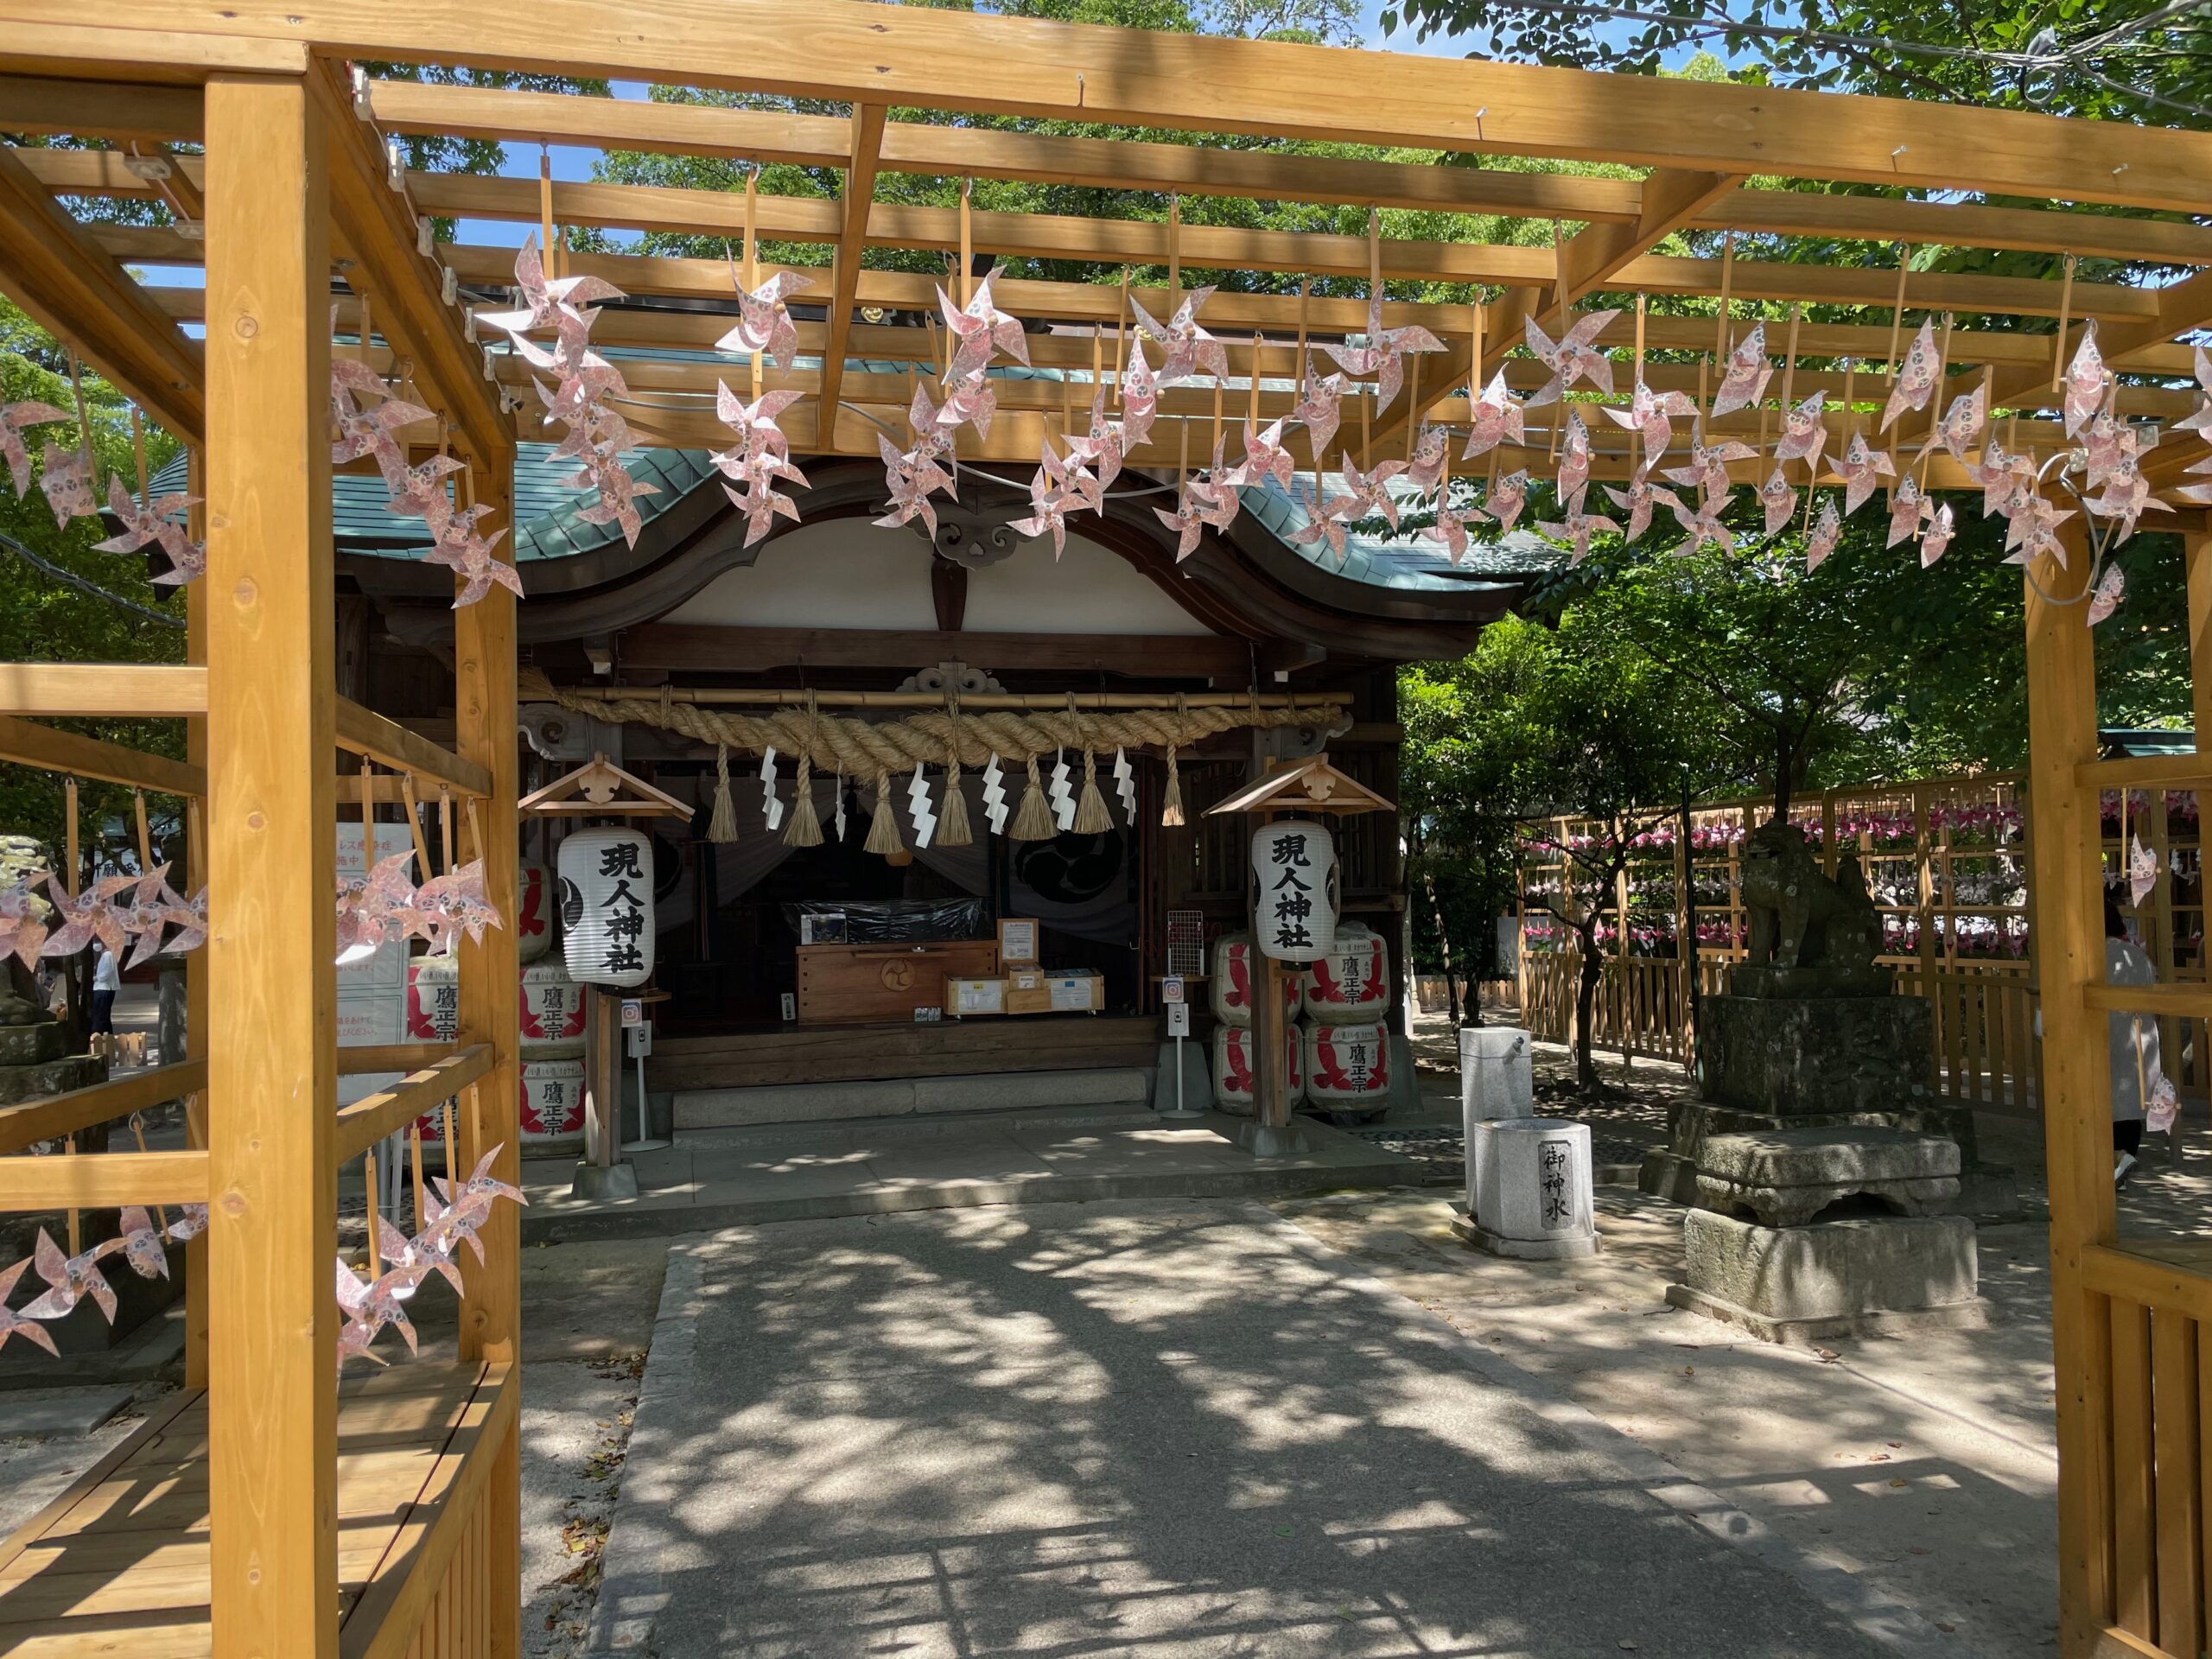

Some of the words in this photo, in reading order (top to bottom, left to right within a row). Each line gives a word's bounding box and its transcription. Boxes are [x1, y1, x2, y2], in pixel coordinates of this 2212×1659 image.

[599, 842, 645, 974] 現人神社
[1271, 834, 1313, 949] 現人神社
[1342, 956, 1361, 1005] 鷹正宗
[435, 985, 458, 1042] 鷹正宗
[542, 986, 564, 1040] 鷹正宗
[1349, 1043, 1367, 1093] 鷹正宗
[542, 1080, 565, 1136] 鷹正宗
[1543, 1145, 1571, 1223] 御神水
